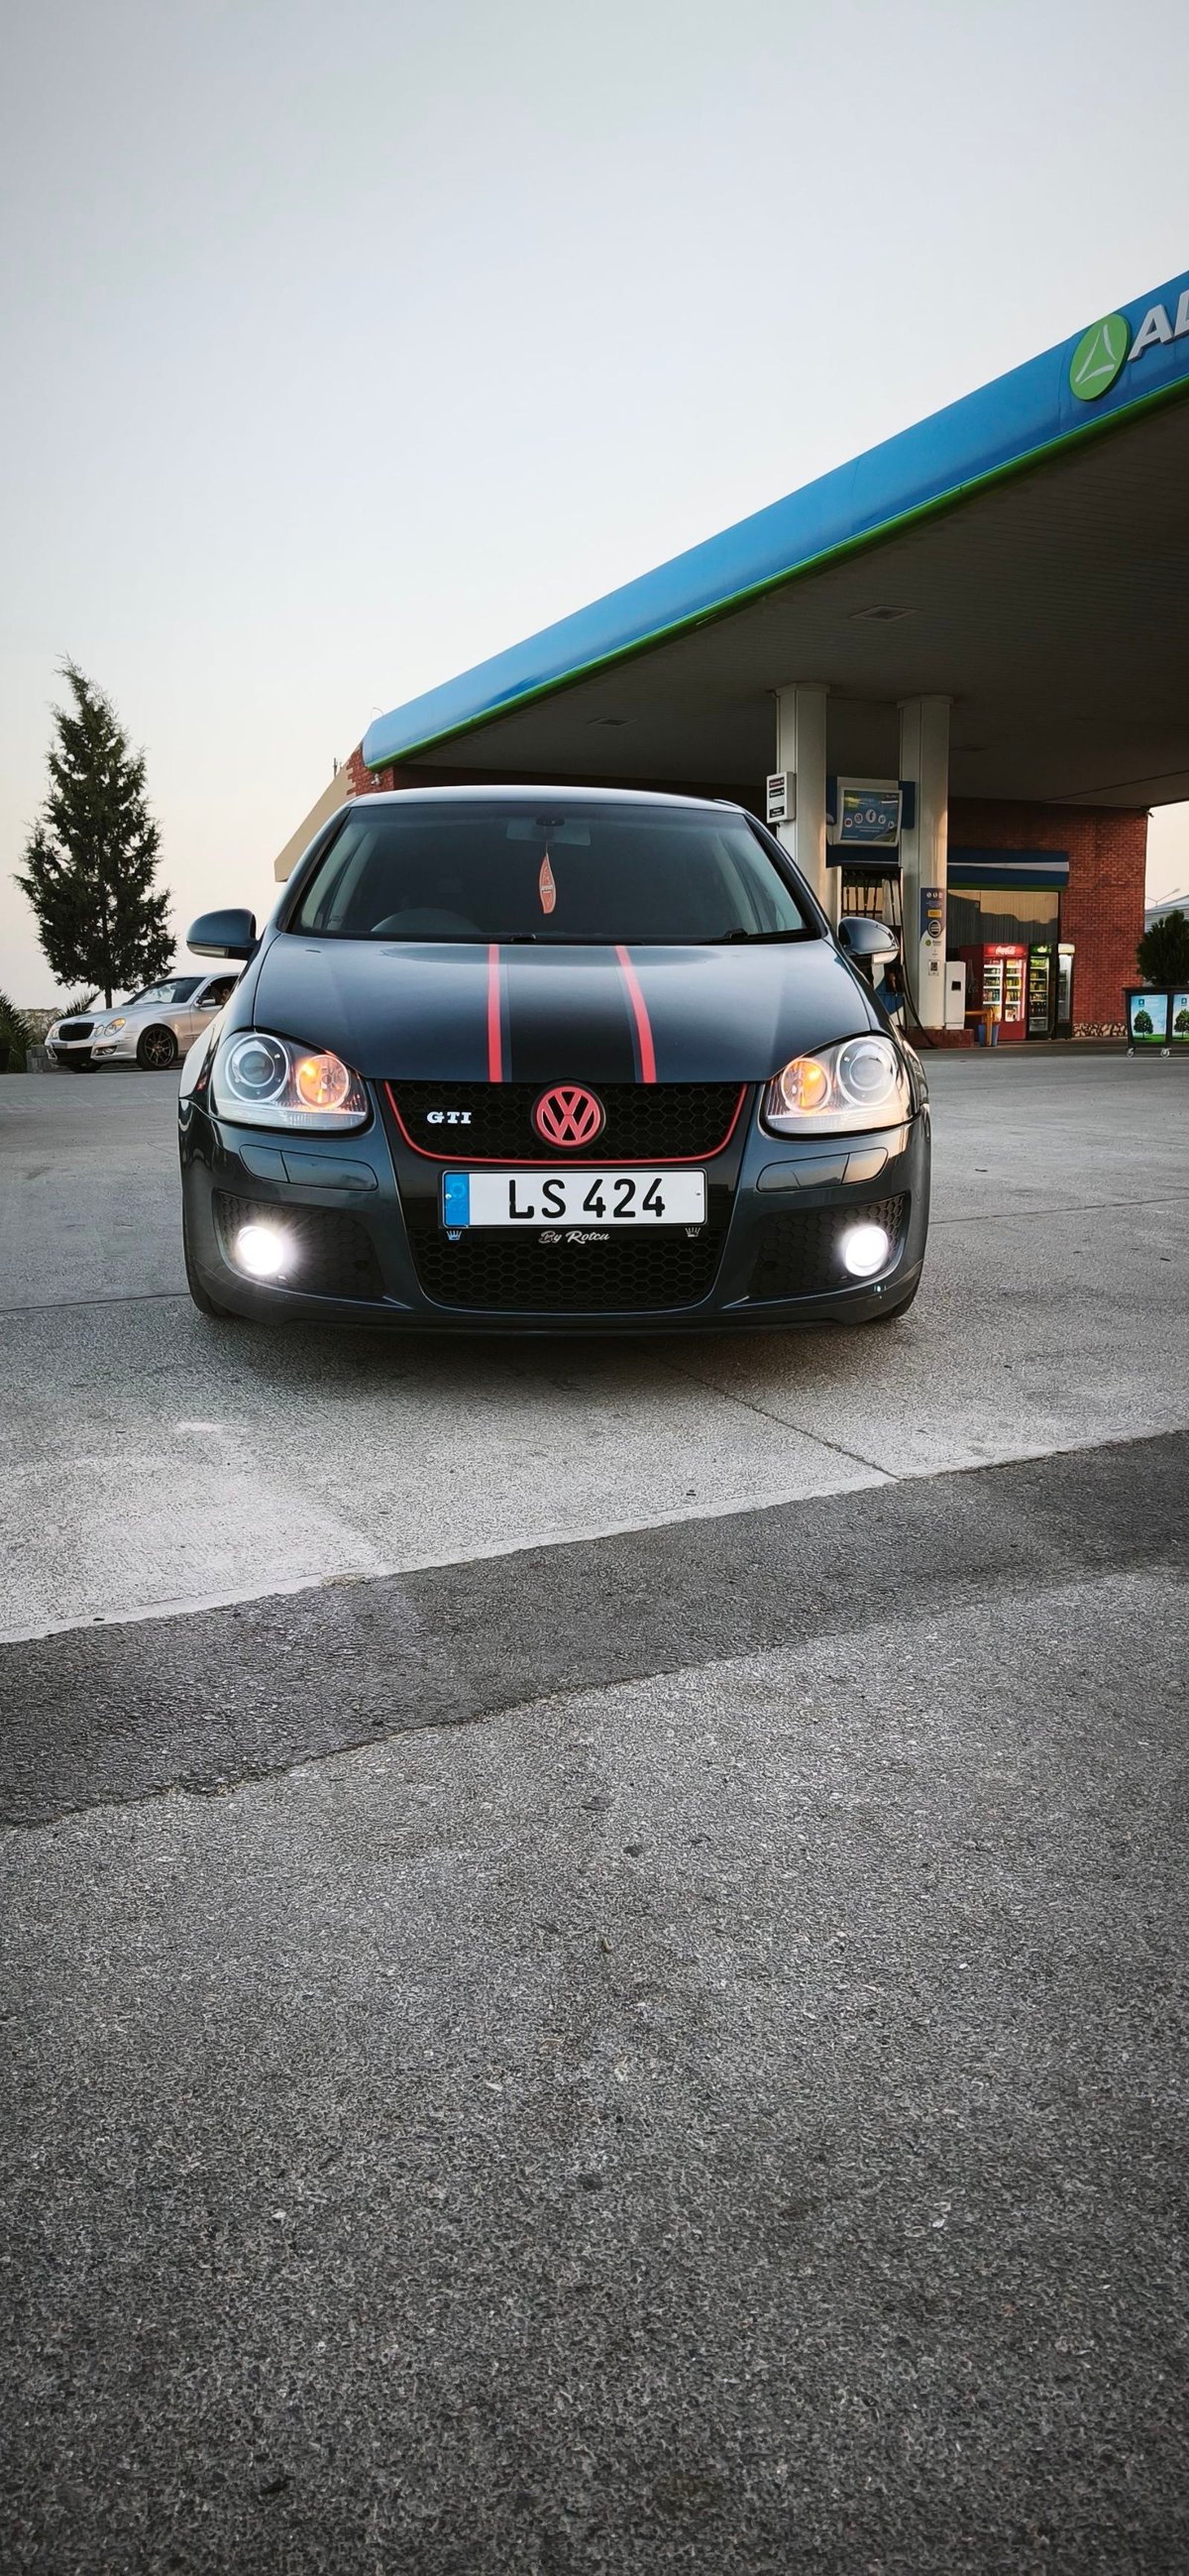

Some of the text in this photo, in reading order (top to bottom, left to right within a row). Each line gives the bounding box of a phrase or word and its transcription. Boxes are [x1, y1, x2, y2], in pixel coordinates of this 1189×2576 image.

[426, 1111, 473, 1124] GTI
[509, 1177, 666, 1219] LS 424
[538, 1230, 563, 1244] By
